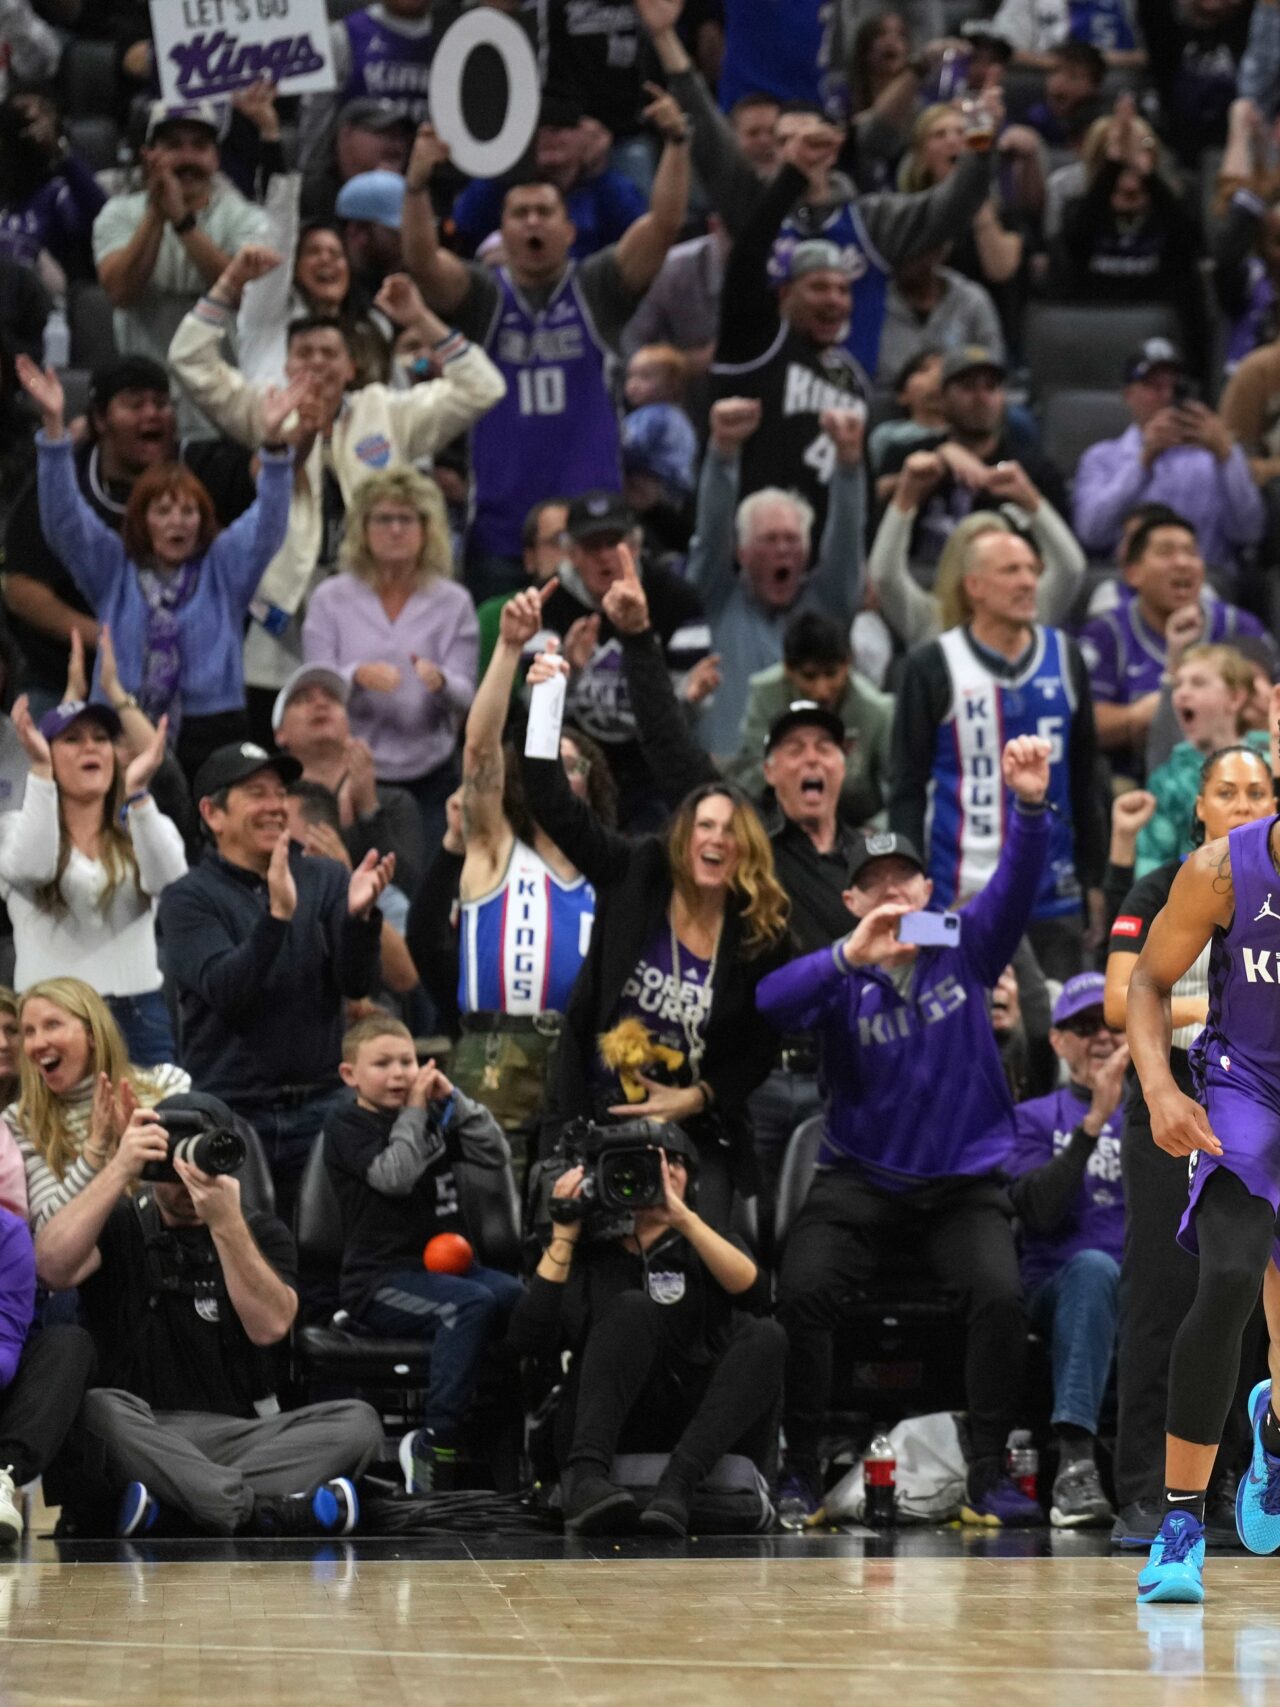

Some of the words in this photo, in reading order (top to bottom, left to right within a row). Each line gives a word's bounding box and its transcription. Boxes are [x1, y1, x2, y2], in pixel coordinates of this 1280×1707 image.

[168, 30, 325, 99] Kings
[518, 367, 565, 415] 10
[804, 432, 838, 483] 4
